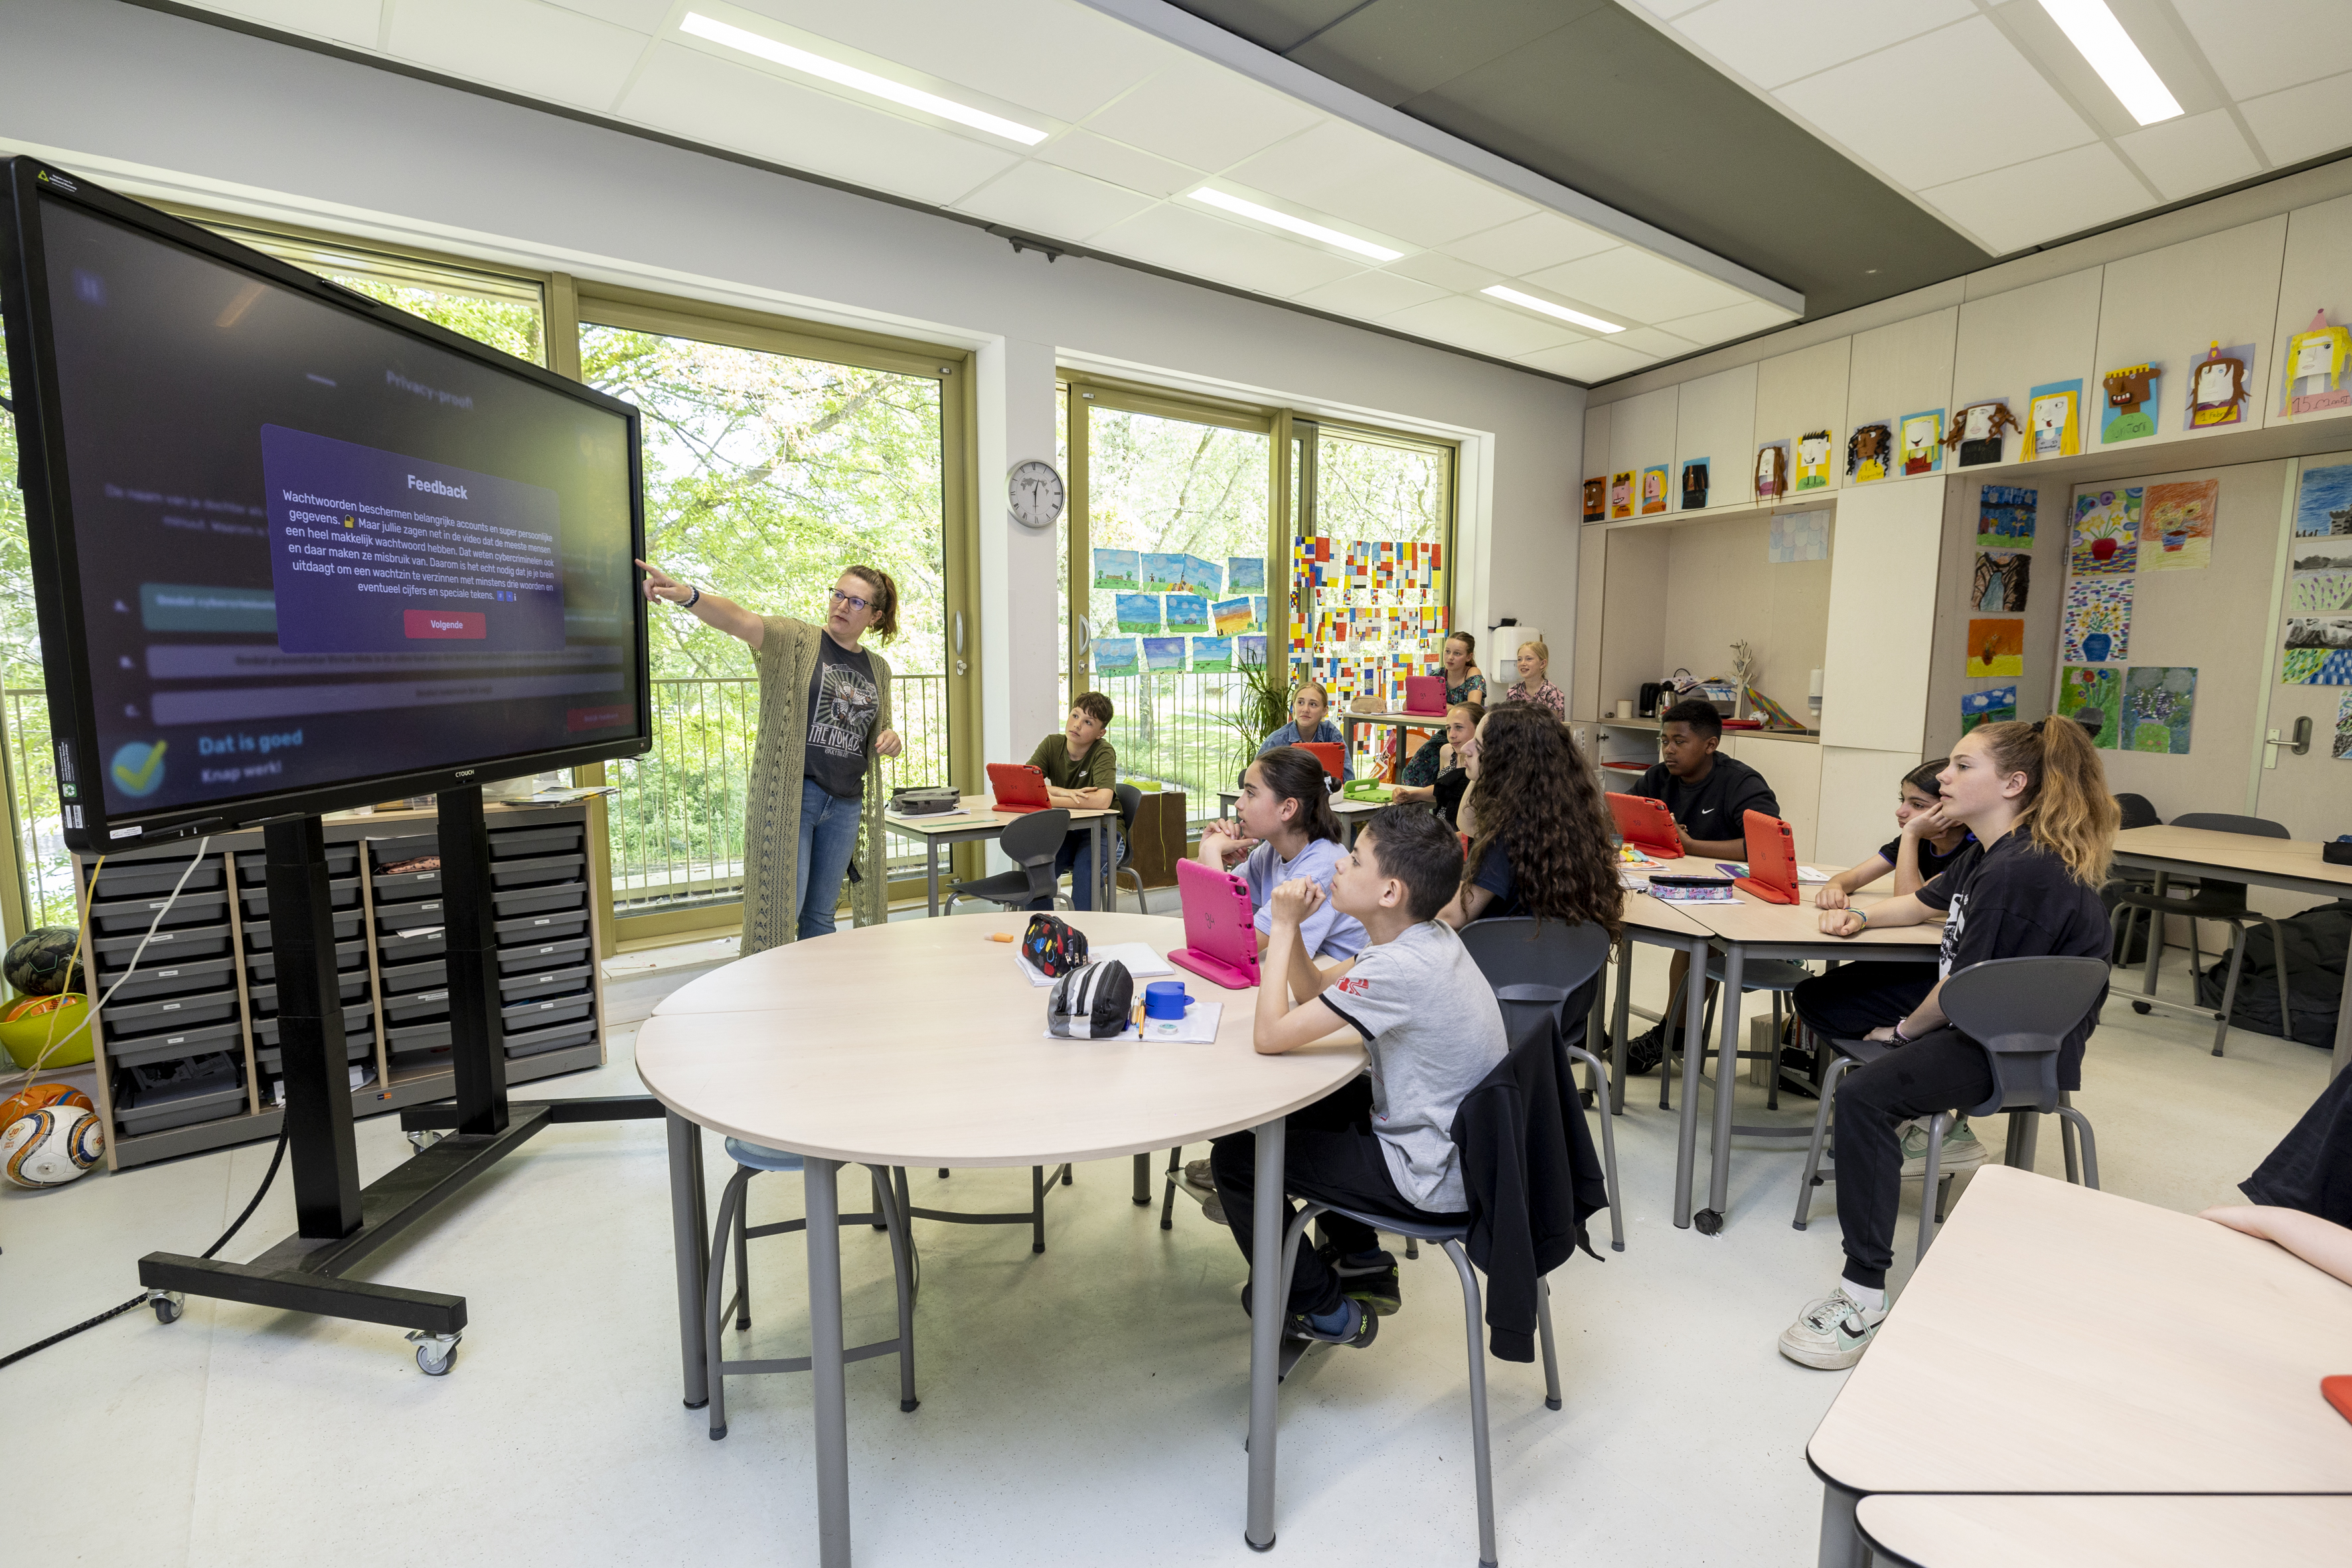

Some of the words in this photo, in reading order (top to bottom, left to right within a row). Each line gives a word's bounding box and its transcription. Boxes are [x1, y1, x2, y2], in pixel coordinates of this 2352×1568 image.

[2292, 397, 2310, 413] 15
[408, 475, 468, 499] Feedback
[283, 489, 356, 511] Wachtwoorden
[358, 502, 412, 520] beschermen
[414, 511, 455, 528] belangrijke
[456, 520, 489, 532] accounts
[499, 527, 517, 537] super
[518, 530, 552, 543] persoonlijke
[289, 510, 341, 525] gegevens.
[358, 518, 380, 530] Maar
[382, 520, 402, 533] jullie
[403, 526, 428, 538] zagen
[430, 530, 442, 539] net
[443, 530, 452, 540] in
[452, 532, 461, 542] de
[462, 534, 481, 544] video
[483, 536, 494, 546] dat
[495, 538, 503, 548] de
[504, 541, 527, 551] meeste
[528, 544, 551, 554] mensen
[285, 526, 305, 537] een
[307, 527, 329, 540] heel
[331, 532, 374, 547] makkelijk
[375, 538, 426, 552] wachtwoord
[428, 543, 457, 555] hebben.
[459, 546, 471, 557] Dat
[473, 550, 493, 559] weten
[495, 552, 542, 565] cybercriminelen
[288, 544, 301, 554] en
[305, 544, 327, 556] daar
[329, 548, 360, 559] maken
[362, 552, 372, 561] ze
[374, 552, 410, 564] misbruik
[430, 557, 458, 569] Daarom
[459, 561, 466, 570] is
[467, 562, 479, 572] het
[481, 564, 495, 573] echt
[497, 566, 514, 578] nodig
[515, 568, 526, 576] dat
[526, 570, 532, 578] je
[532, 570, 539, 579] je
[540, 570, 554, 579] brein
[292, 560, 335, 576] uitdaagt
[337, 566, 352, 575] om
[354, 567, 371, 576] een
[372, 568, 411, 579] wachtzin
[412, 570, 420, 580] te
[422, 573, 459, 584] verzinnen
[460, 576, 474, 585] met
[475, 578, 506, 588] minstens
[507, 580, 518, 589] drie
[358, 583, 400, 593] eventueel
[402, 584, 427, 597] cijfers
[439, 589, 469, 599] speciale
[470, 589, 495, 600] tekens.
[431, 620, 463, 631] Volgende
[200, 736, 234, 755] Dat
[239, 733, 255, 751] is
[259, 730, 303, 753] goed
[809, 725, 828, 744] THE
[202, 769, 240, 783] Knap
